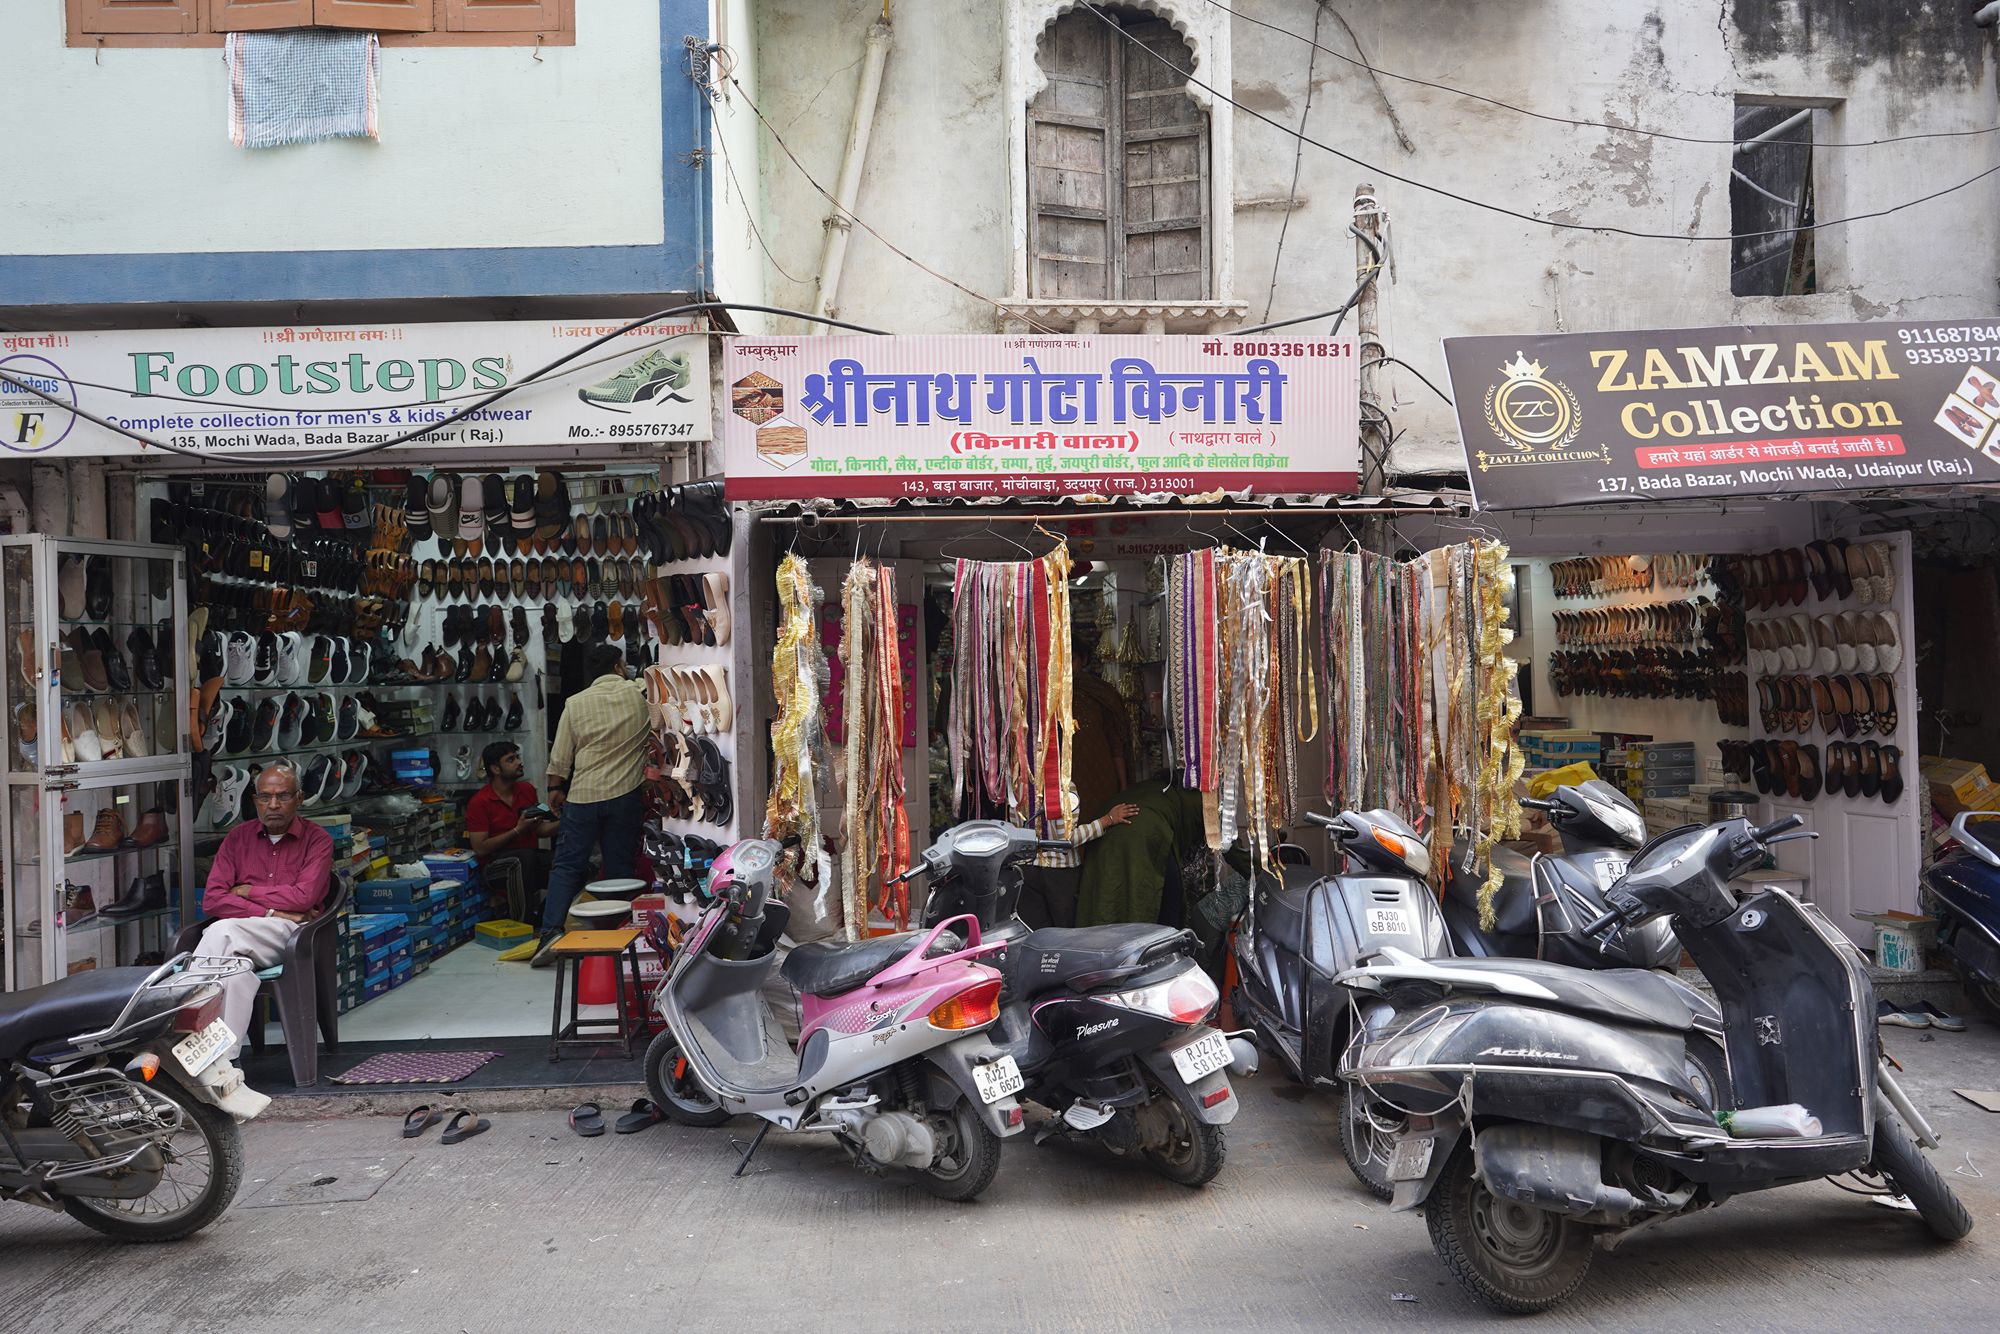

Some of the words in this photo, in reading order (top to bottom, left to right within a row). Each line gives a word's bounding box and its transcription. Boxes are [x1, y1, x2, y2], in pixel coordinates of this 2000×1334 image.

[734, 344, 798, 361] जम्बुकुमार
[1028, 338, 1062, 350] गणेशाय
[1202, 338, 1228, 358] मो.
[1233, 342, 1352, 358] 8003361831
[1590, 340, 1900, 392] ZAMZAM
[128, 352, 508, 404] Footsteps
[800, 358, 977, 426] श्रीनाथ
[984, 355, 1103, 426] गोटा
[1110, 357, 1288, 425] किनारी
[200, 412, 290, 429] collection
[296, 411, 322, 425] for
[328, 409, 382, 425] men's
[388, 409, 401, 424] &
[408, 408, 446, 422] kids
[1621, 394, 1902, 439] Collection
[13, 412, 44, 443] F
[568, 425, 604, 438] Mo.:-
[609, 423, 694, 437] 8955767347
[1234, 428, 1262, 445] वाले
[170, 436, 200, 449] 135,
[205, 435, 250, 448] Mochi
[254, 434, 299, 448] Wada,
[305, 432, 342, 445] Bada
[471, 428, 503, 444] Raj.)
[1488, 455, 1511, 465] ZAM
[1513, 454, 1536, 464] ZAM
[1538, 450, 1600, 463] COLLECTION
[1647, 446, 1680, 464] हमारे
[1746, 443, 1760, 458] से
[1808, 438, 1840, 455] बनाई
[1842, 437, 1872, 453] जाती
[810, 455, 842, 473] गोटा,
[845, 455, 892, 474] किनारी,
[1060, 453, 1100, 473] जयपुरी
[1163, 453, 1190, 469] आदि
[1191, 452, 1204, 469] के
[1597, 477, 1635, 494] 137,
[1638, 474, 1681, 491] Bada
[1686, 471, 1738, 488] Bazar,
[1741, 465, 1795, 485] Mochi
[1796, 463, 1853, 482] Wada,
[1856, 459, 1923, 479] Udaipur
[1927, 457, 1973, 476] (Raj.)
[901, 480, 929, 494] 143,
[932, 479, 957, 494] बड़ा
[959, 479, 998, 493] बाजार,
[1064, 478, 1102, 494] उदयपुर
[1150, 478, 1195, 490] 313001
[1377, 911, 1399, 921] RJ30
[1371, 921, 1384, 932] SB
[1386, 921, 1407, 932] 8010
[863, 1008, 899, 1026] Scooty
[1076, 1018, 1120, 1041] Pleasure
[1477, 1046, 1564, 1059] Activa
[985, 1066, 1007, 1084] RJ27
[982, 1086, 996, 1100] SG
[999, 1075, 1021, 1094] 6627
